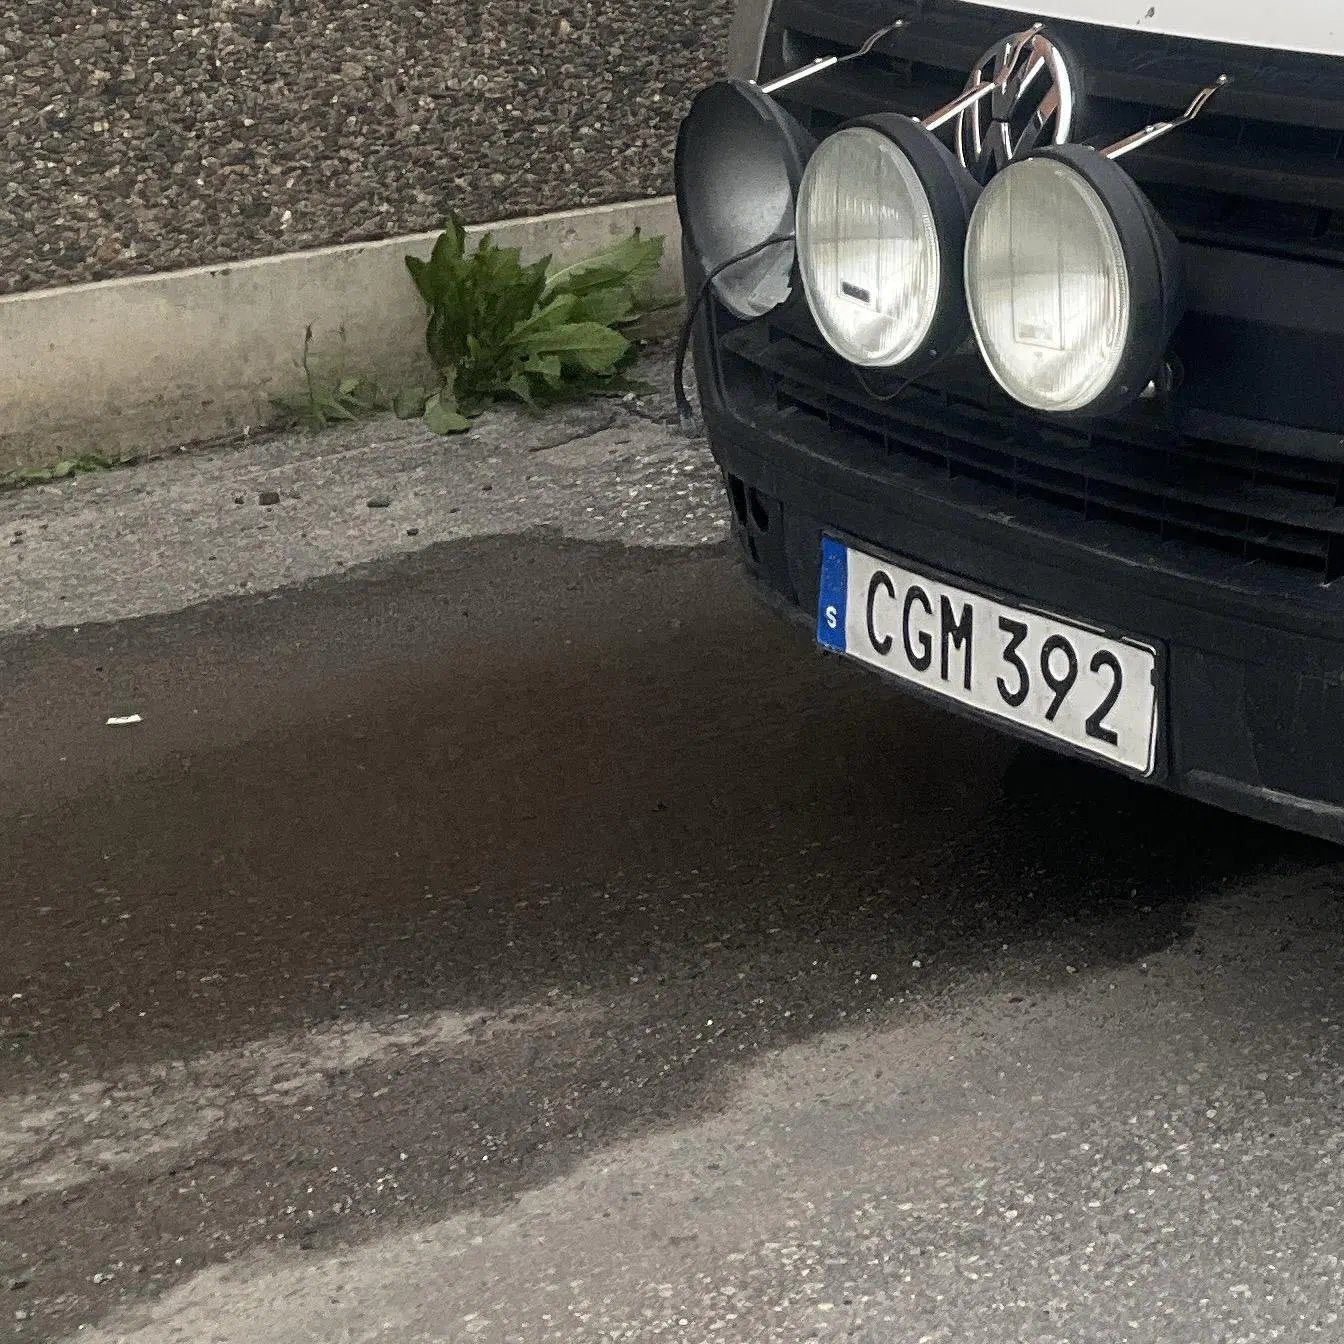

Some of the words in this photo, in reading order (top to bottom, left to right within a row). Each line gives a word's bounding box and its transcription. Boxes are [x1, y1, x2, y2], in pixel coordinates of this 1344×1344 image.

[824, 605, 838, 629] S
[865, 569, 974, 692] CGM
[996, 614, 1124, 747] 392
